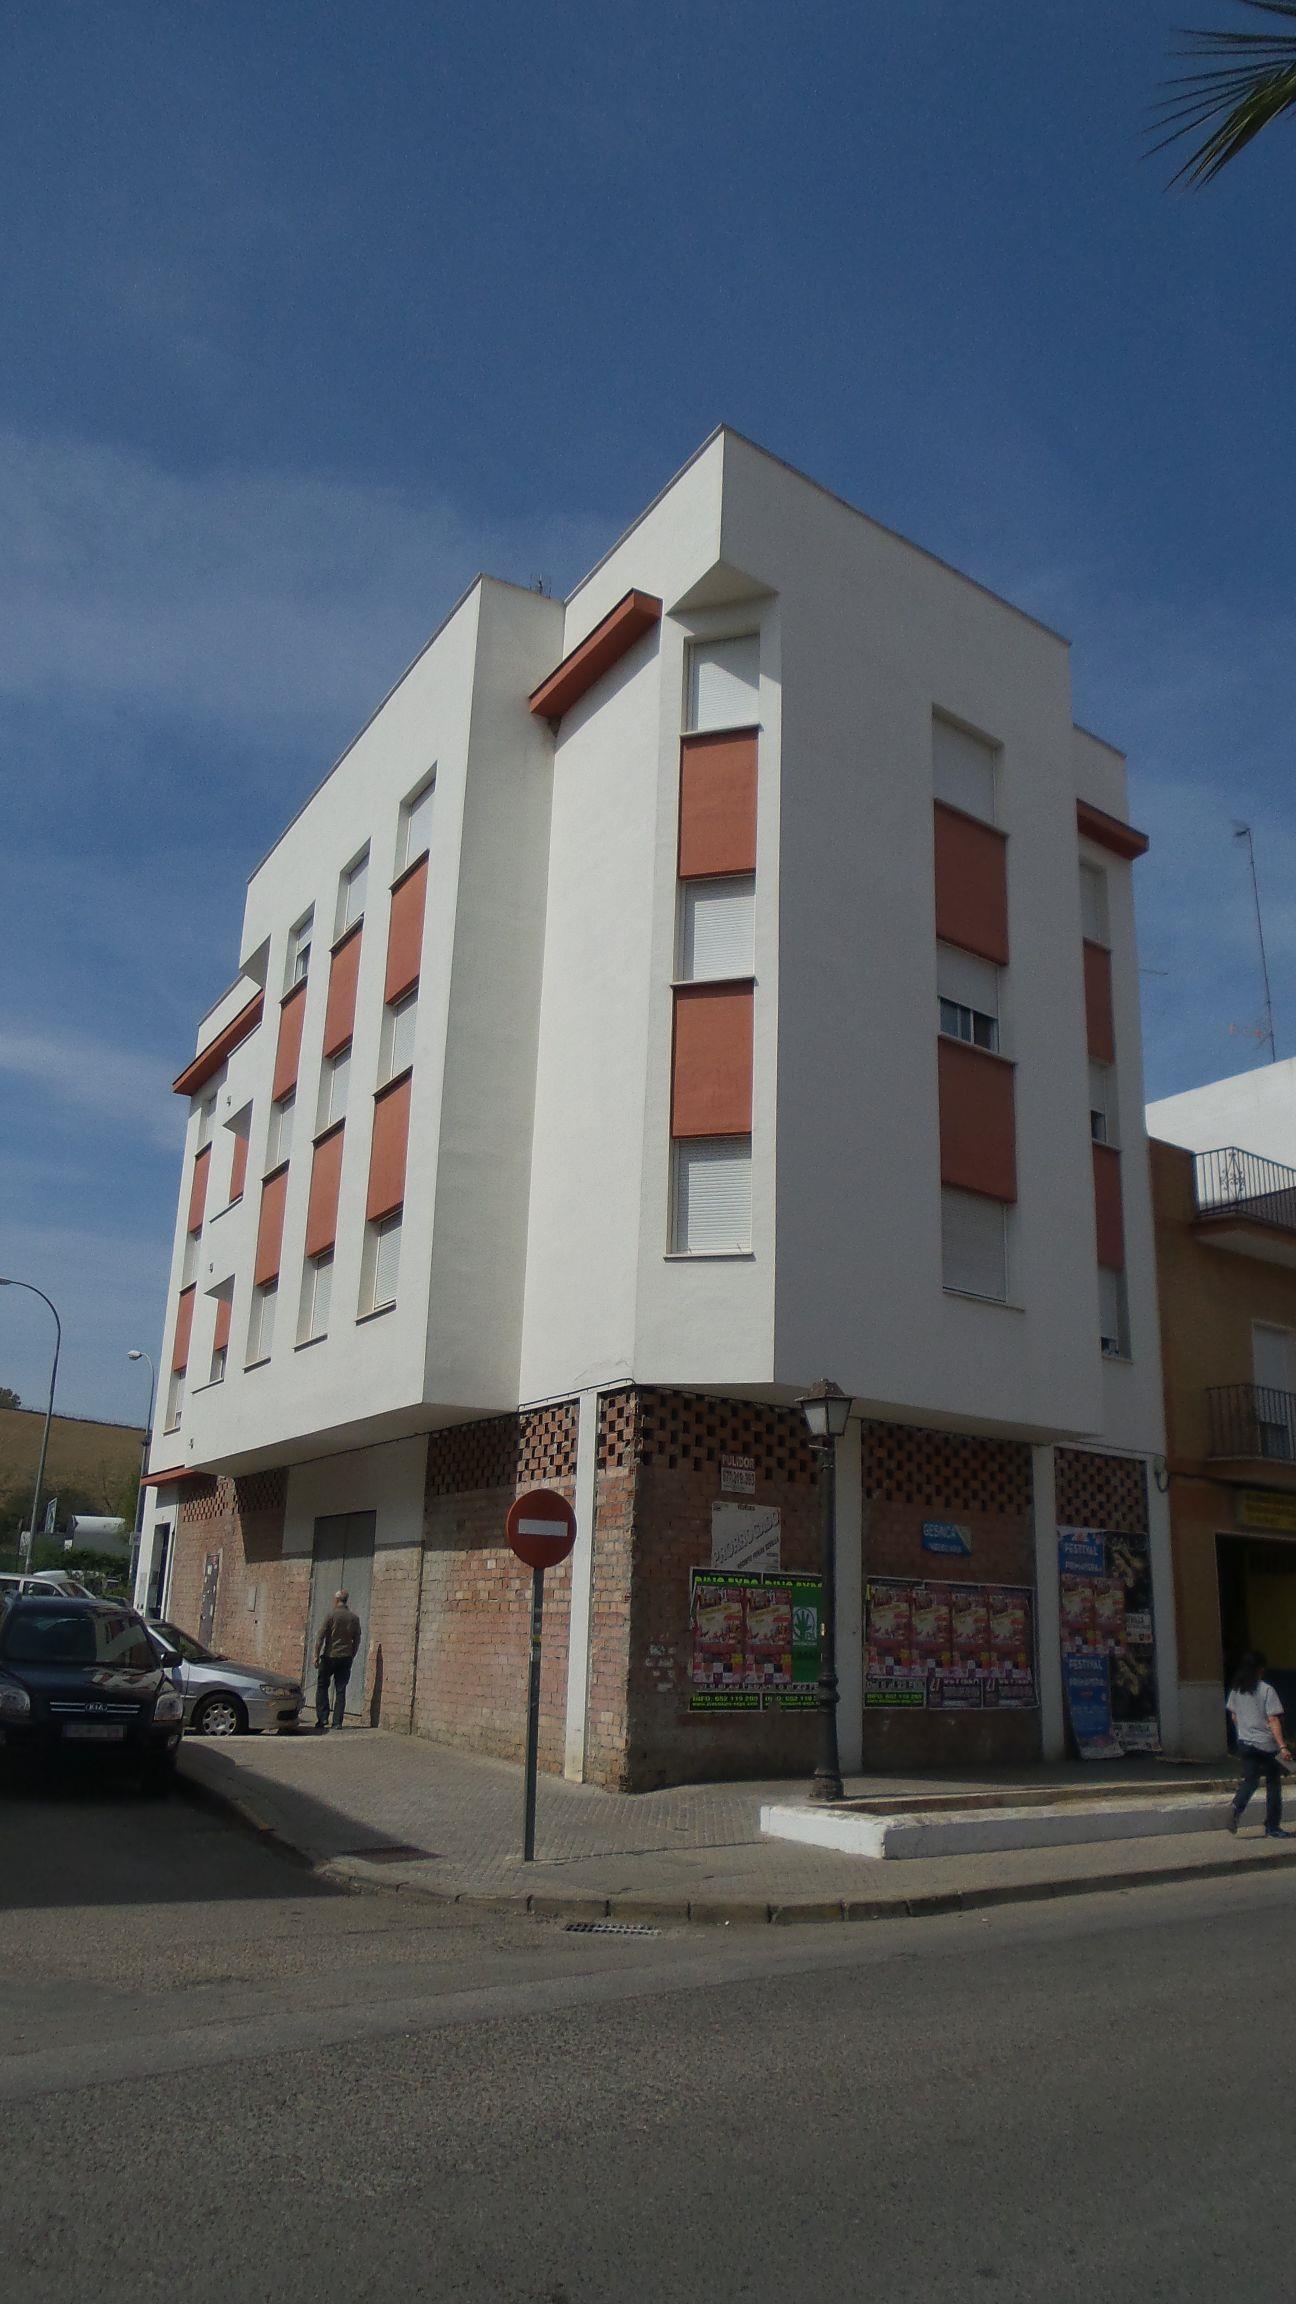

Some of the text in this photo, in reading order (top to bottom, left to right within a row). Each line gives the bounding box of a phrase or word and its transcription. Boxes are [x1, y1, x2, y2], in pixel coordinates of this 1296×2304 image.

[722, 1455, 755, 1469] PULIDOR
[1064, 1542, 1098, 1555] FESTIVAL
[1068, 1658, 1103, 1671] FESTIVAL
[89, 1704, 103, 1712] KIA
